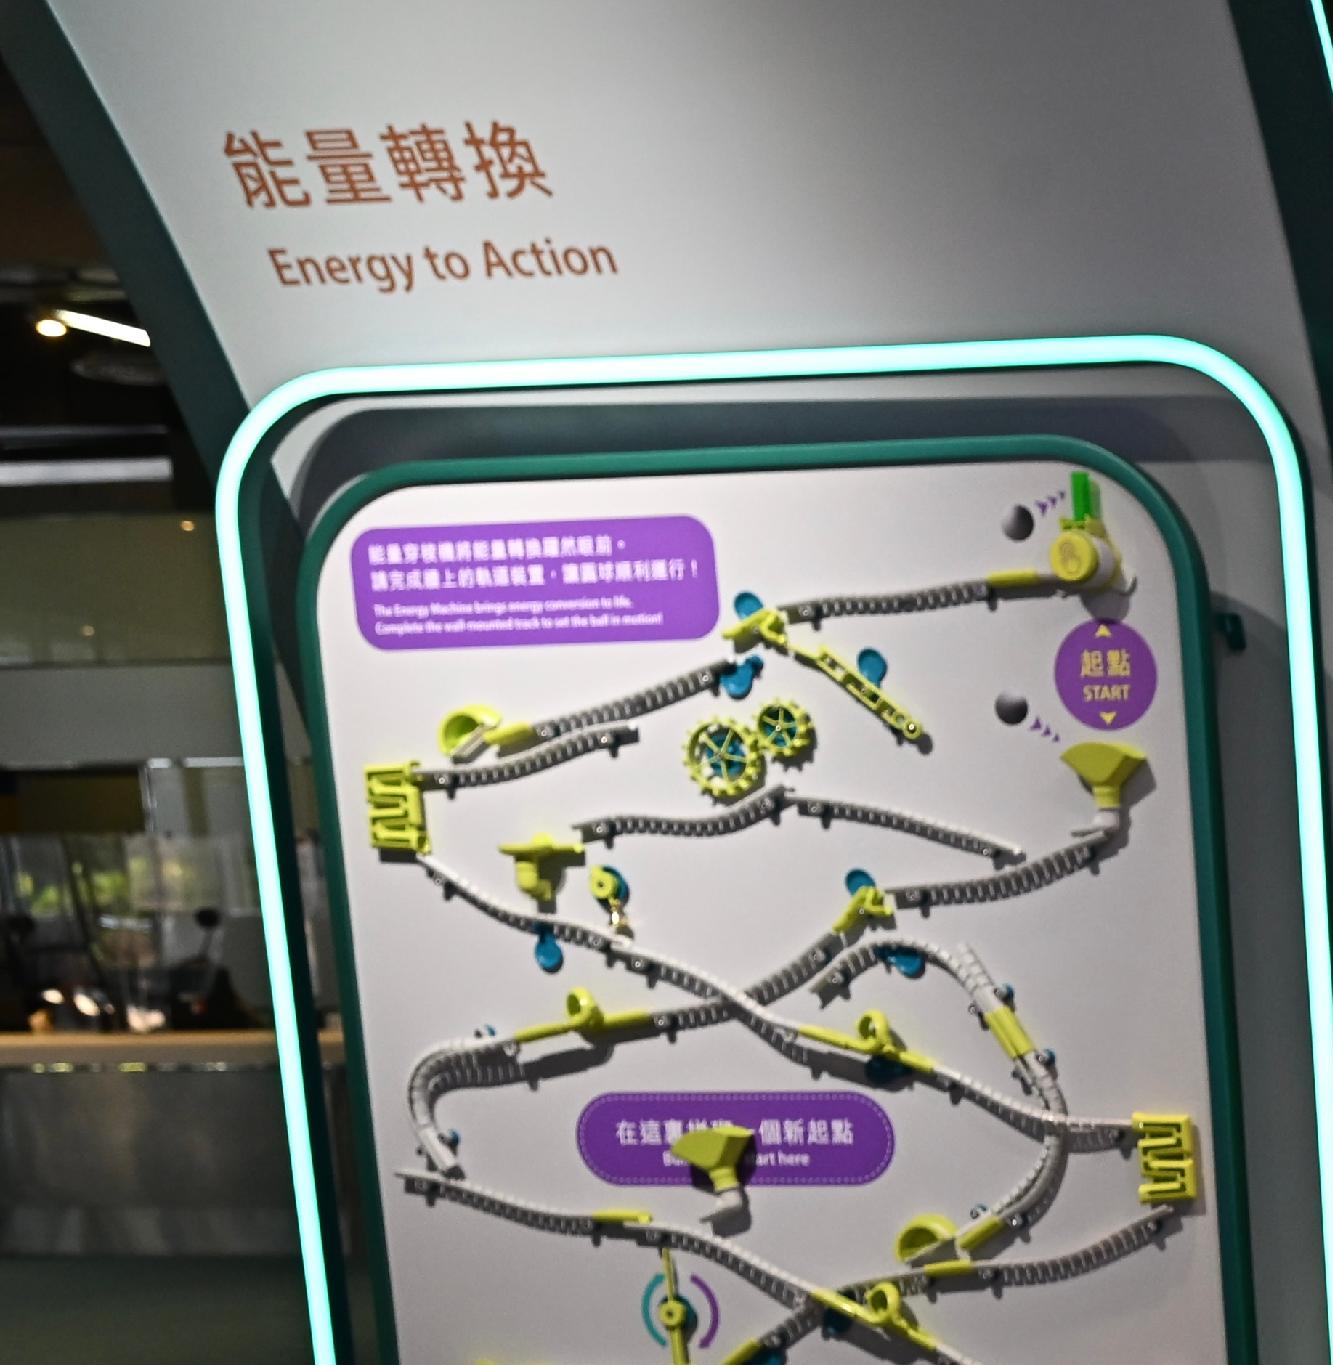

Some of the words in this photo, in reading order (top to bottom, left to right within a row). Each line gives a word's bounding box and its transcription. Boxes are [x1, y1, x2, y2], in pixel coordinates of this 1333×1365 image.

[223, 120, 553, 209] 能量轉換
[268, 247, 415, 293] Energy
[424, 246, 470, 281] to
[483, 238, 618, 278] Action
[1081, 648, 1131, 678] 起點
[1083, 684, 1131, 702] START
[778, 1150, 810, 1166] here
